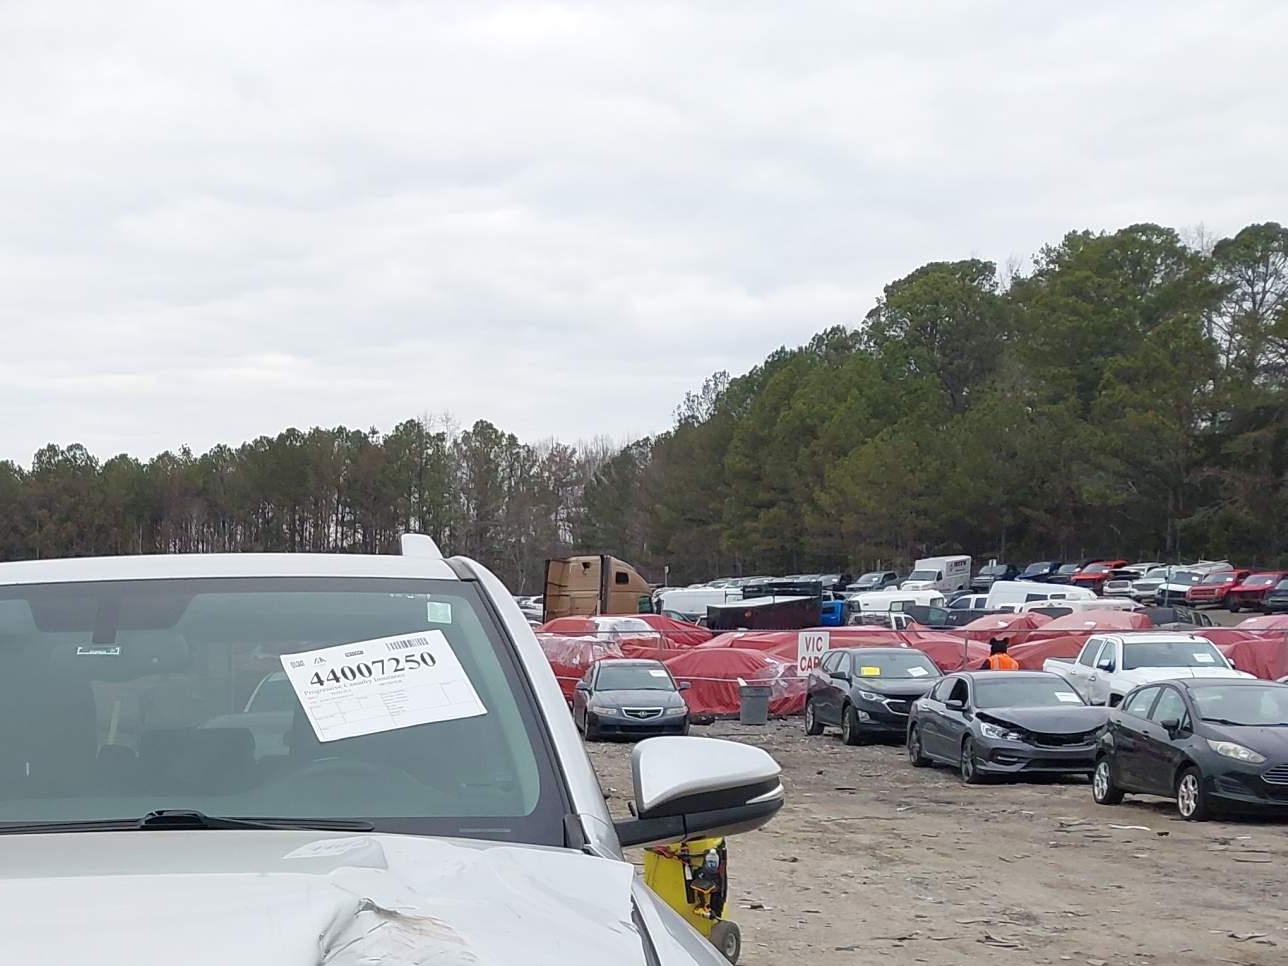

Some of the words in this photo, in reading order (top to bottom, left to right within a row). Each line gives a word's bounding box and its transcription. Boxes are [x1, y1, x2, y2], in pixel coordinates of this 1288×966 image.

[804, 636, 823, 652] VIC
[310, 651, 436, 686] 44007250
[799, 656, 821, 671] CAR
